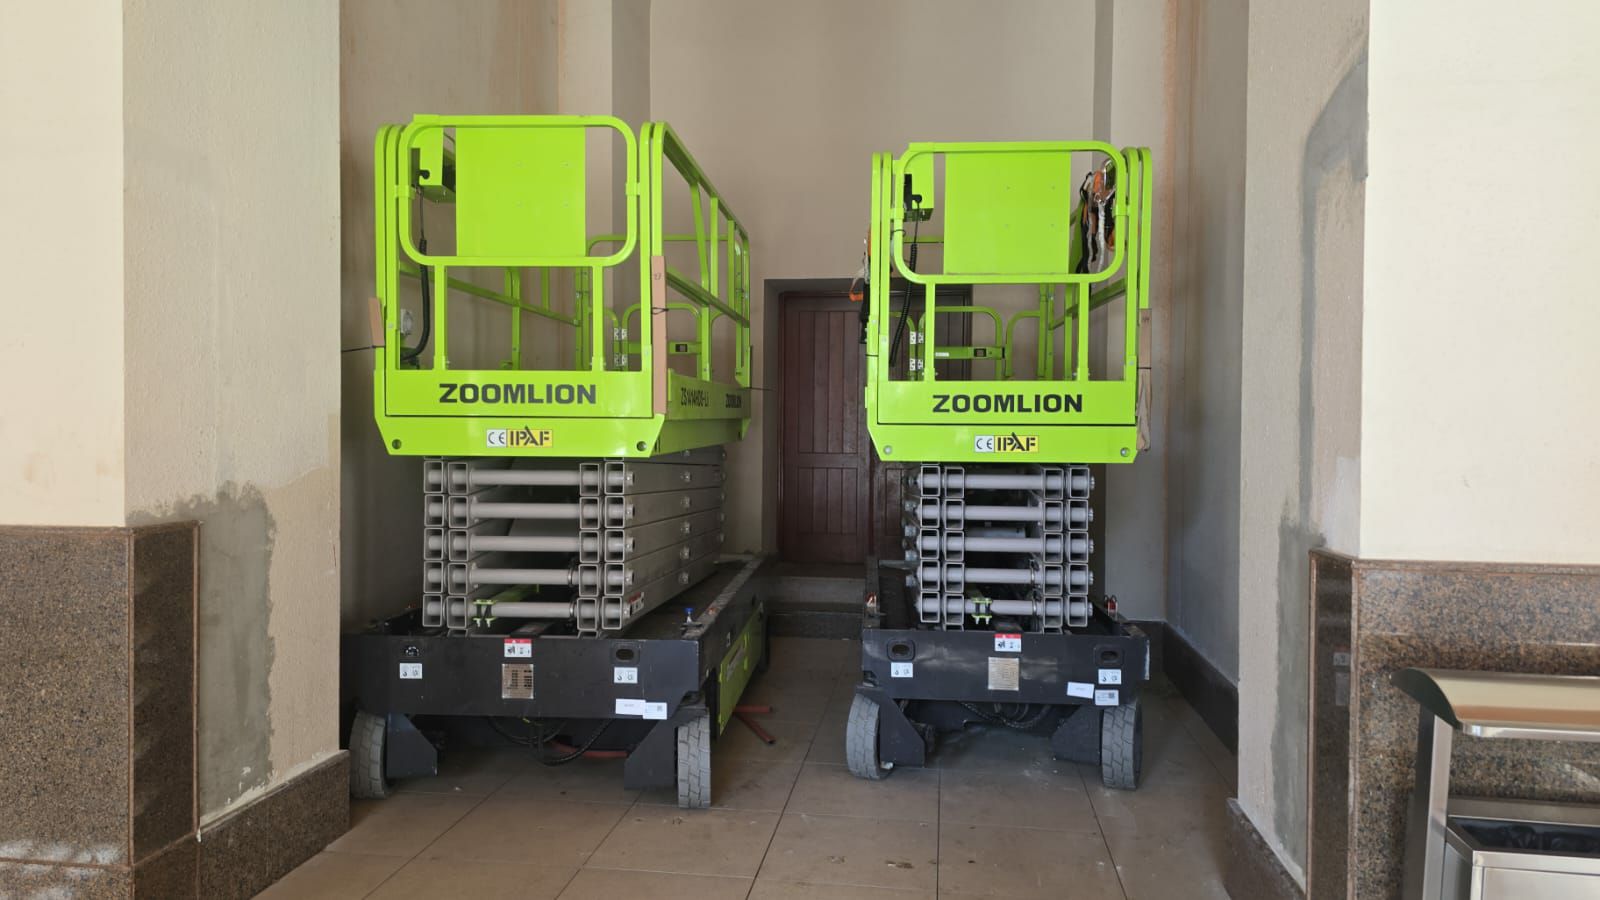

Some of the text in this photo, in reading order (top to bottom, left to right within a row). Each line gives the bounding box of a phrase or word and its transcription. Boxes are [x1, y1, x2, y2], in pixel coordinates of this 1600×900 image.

[439, 383, 596, 405] ZOOMLION
[932, 394, 1083, 413] ZOOMLION
[487, 425, 550, 447] CE IPAF
[976, 432, 1036, 453] CE IPAF
